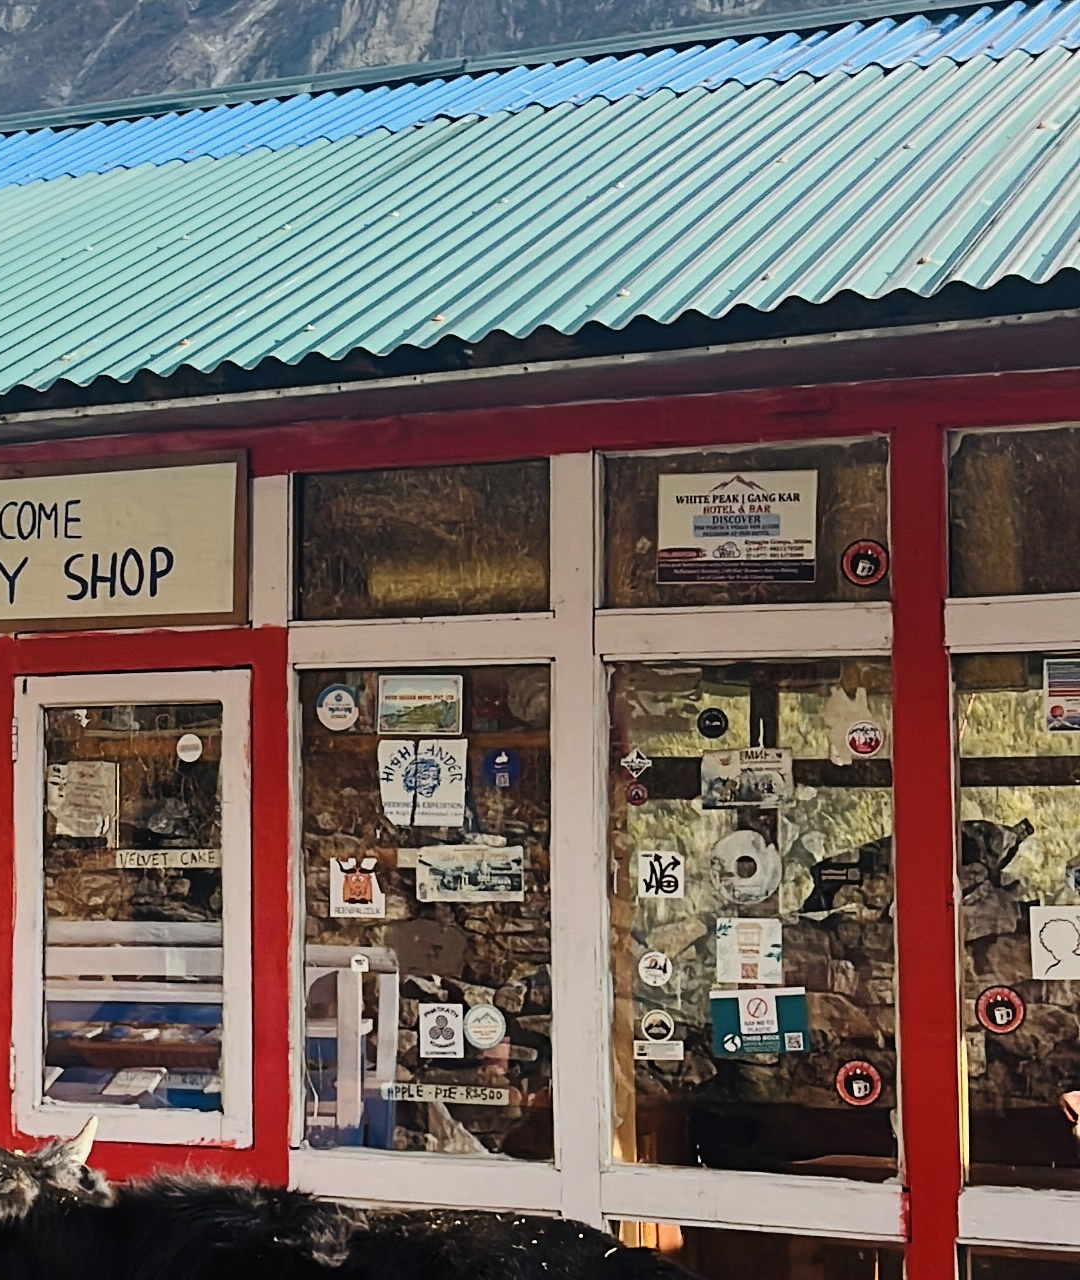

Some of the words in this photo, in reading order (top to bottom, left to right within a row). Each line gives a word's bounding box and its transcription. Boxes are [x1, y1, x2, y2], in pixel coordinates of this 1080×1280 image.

[676, 495, 709, 504] WHITE
[712, 494, 738, 504] PEAK
[747, 493, 776, 503] GANG
[778, 493, 800, 502] KAR
[703, 505, 735, 514] HOTEL
[749, 505, 771, 513] BAR
[712, 515, 761, 524] DISCOVER
[64, 546, 174, 601] SHOP
[119, 851, 169, 867] VELVET
[180, 850, 215, 866] CAKE
[387, 1085, 424, 1099] APPLE
